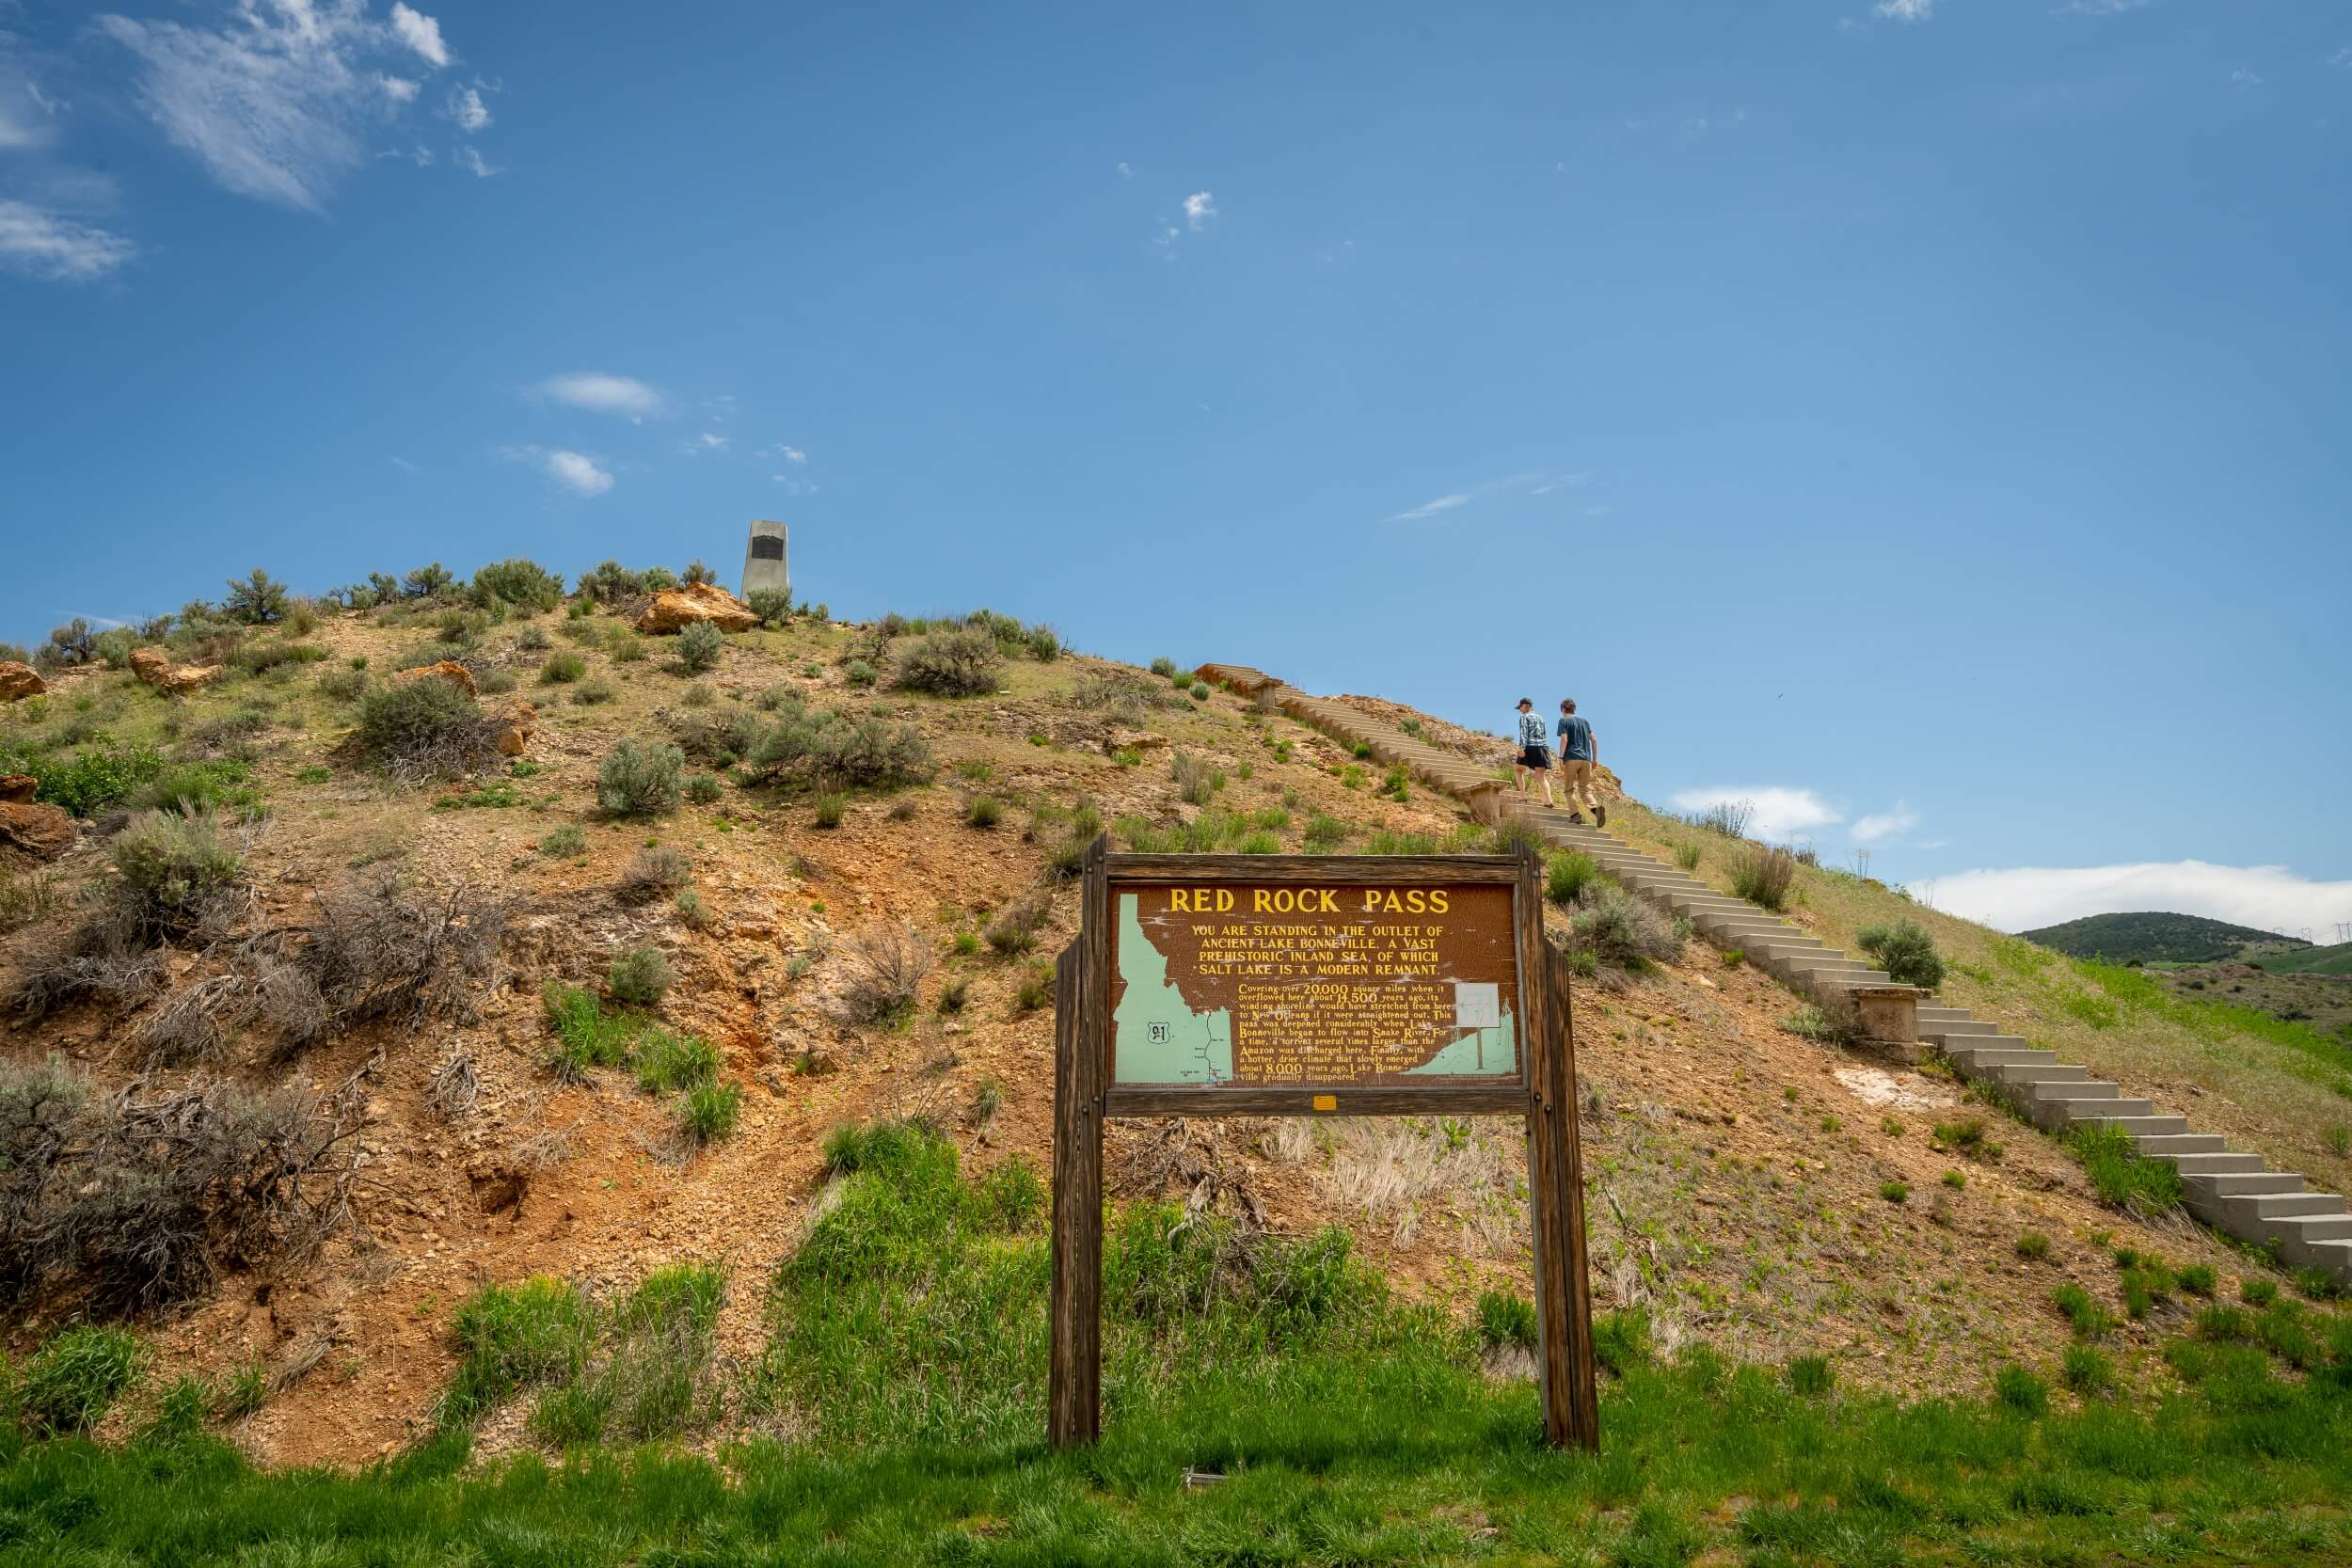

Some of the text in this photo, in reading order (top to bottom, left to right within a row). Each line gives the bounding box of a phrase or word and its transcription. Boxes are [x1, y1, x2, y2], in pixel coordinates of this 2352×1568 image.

[1170, 889, 1449, 912] RED ROCK PASS
[1192, 926, 1443, 936] YOU ARE STANDING IN THE OUTLET OF
[1201, 939, 1255, 949] ANCIENT
[1261, 939, 1295, 949] LAKE
[1389, 939, 1397, 949] A
[1405, 939, 1435, 949] VAST
[1200, 951, 1284, 962] PREHISTORIC
[1291, 951, 1333, 962] INLAND
[1377, 951, 1393, 962] OF
[1401, 951, 1438, 962] WHICH
[1200, 964, 1440, 975] SALT LAKE IS A MODERN REMNANT.
[1238, 984, 1279, 994] Covering
[1353, 986, 1380, 994] square
[1385, 984, 1406, 992] miles
[1411, 984, 1433, 992] when
[1438, 984, 1444, 992] it
[1239, 1002, 1273, 1012] winding
[1348, 1001, 1367, 1009] have
[1252, 1010, 1270, 1021] New
[1275, 1010, 1310, 1021] Orleans
[1358, 1011, 1409, 1022] straightened
[1433, 1009, 1452, 1021] This
[1282, 1020, 1321, 1029] deepened
[1326, 1019, 1377, 1029] considerably
[1383, 1019, 1405, 1027] when
[1152, 1026, 1165, 1040] 91
[1239, 1028, 1285, 1038] Bonneville
[1289, 1028, 1313, 1039] began
[1318, 1028, 1327, 1037] to
[1330, 1027, 1348, 1037] flow
[1353, 1028, 1369, 1037] into
[1374, 1028, 1400, 1038] Snake
[1433, 1028, 1446, 1037] For
[1314, 1036, 1343, 1045] several
[1373, 1035, 1396, 1047] larger
[1422, 1037, 1435, 1045] the
[1240, 1046, 1275, 1055] Amazon
[1297, 1046, 1342, 1056] discharged
[1406, 1046, 1425, 1054] with
[1279, 1054, 1299, 1063] drier
[1302, 1054, 1332, 1063] climate
[1336, 1054, 1352, 1063] that
[1357, 1053, 1383, 1063] slowly
[1386, 1053, 1418, 1065] emerged
[1240, 1064, 1263, 1072] about
[1350, 1063, 1372, 1073] Lake
[1263, 1073, 1302, 1084] gradually
[1306, 1073, 1359, 1082] disappeared.
